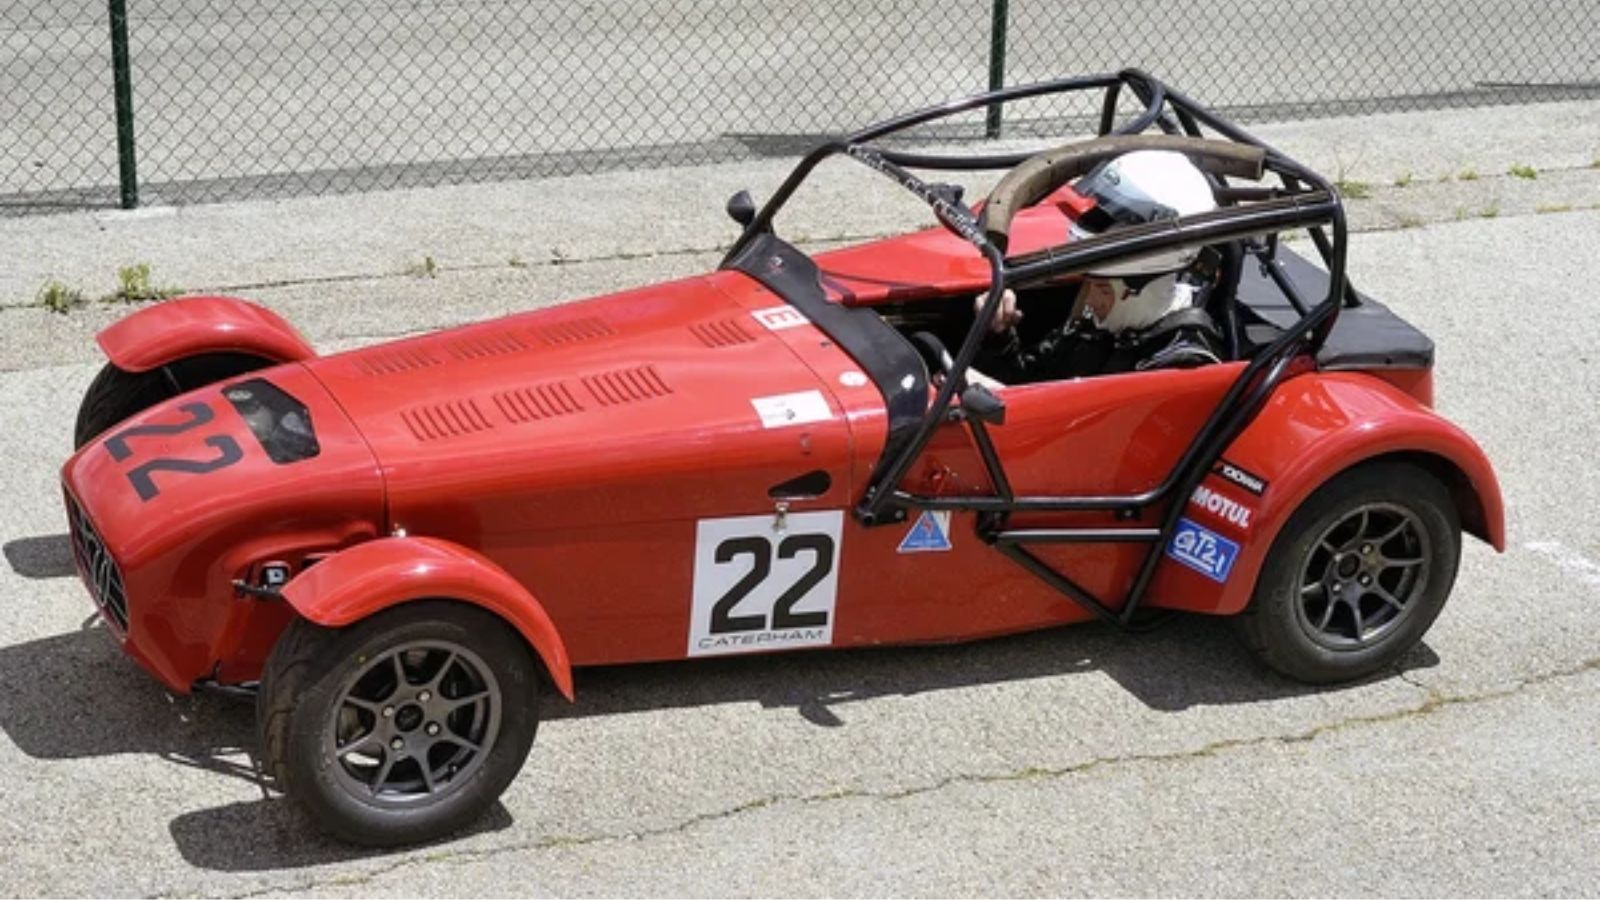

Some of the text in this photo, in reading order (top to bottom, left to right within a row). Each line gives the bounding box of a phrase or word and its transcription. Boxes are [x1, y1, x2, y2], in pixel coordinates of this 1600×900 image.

[104, 402, 243, 502] 22
[1190, 486, 1251, 529] MOTUL
[709, 532, 835, 634] 22
[699, 630, 825, 649] CATERHAM
